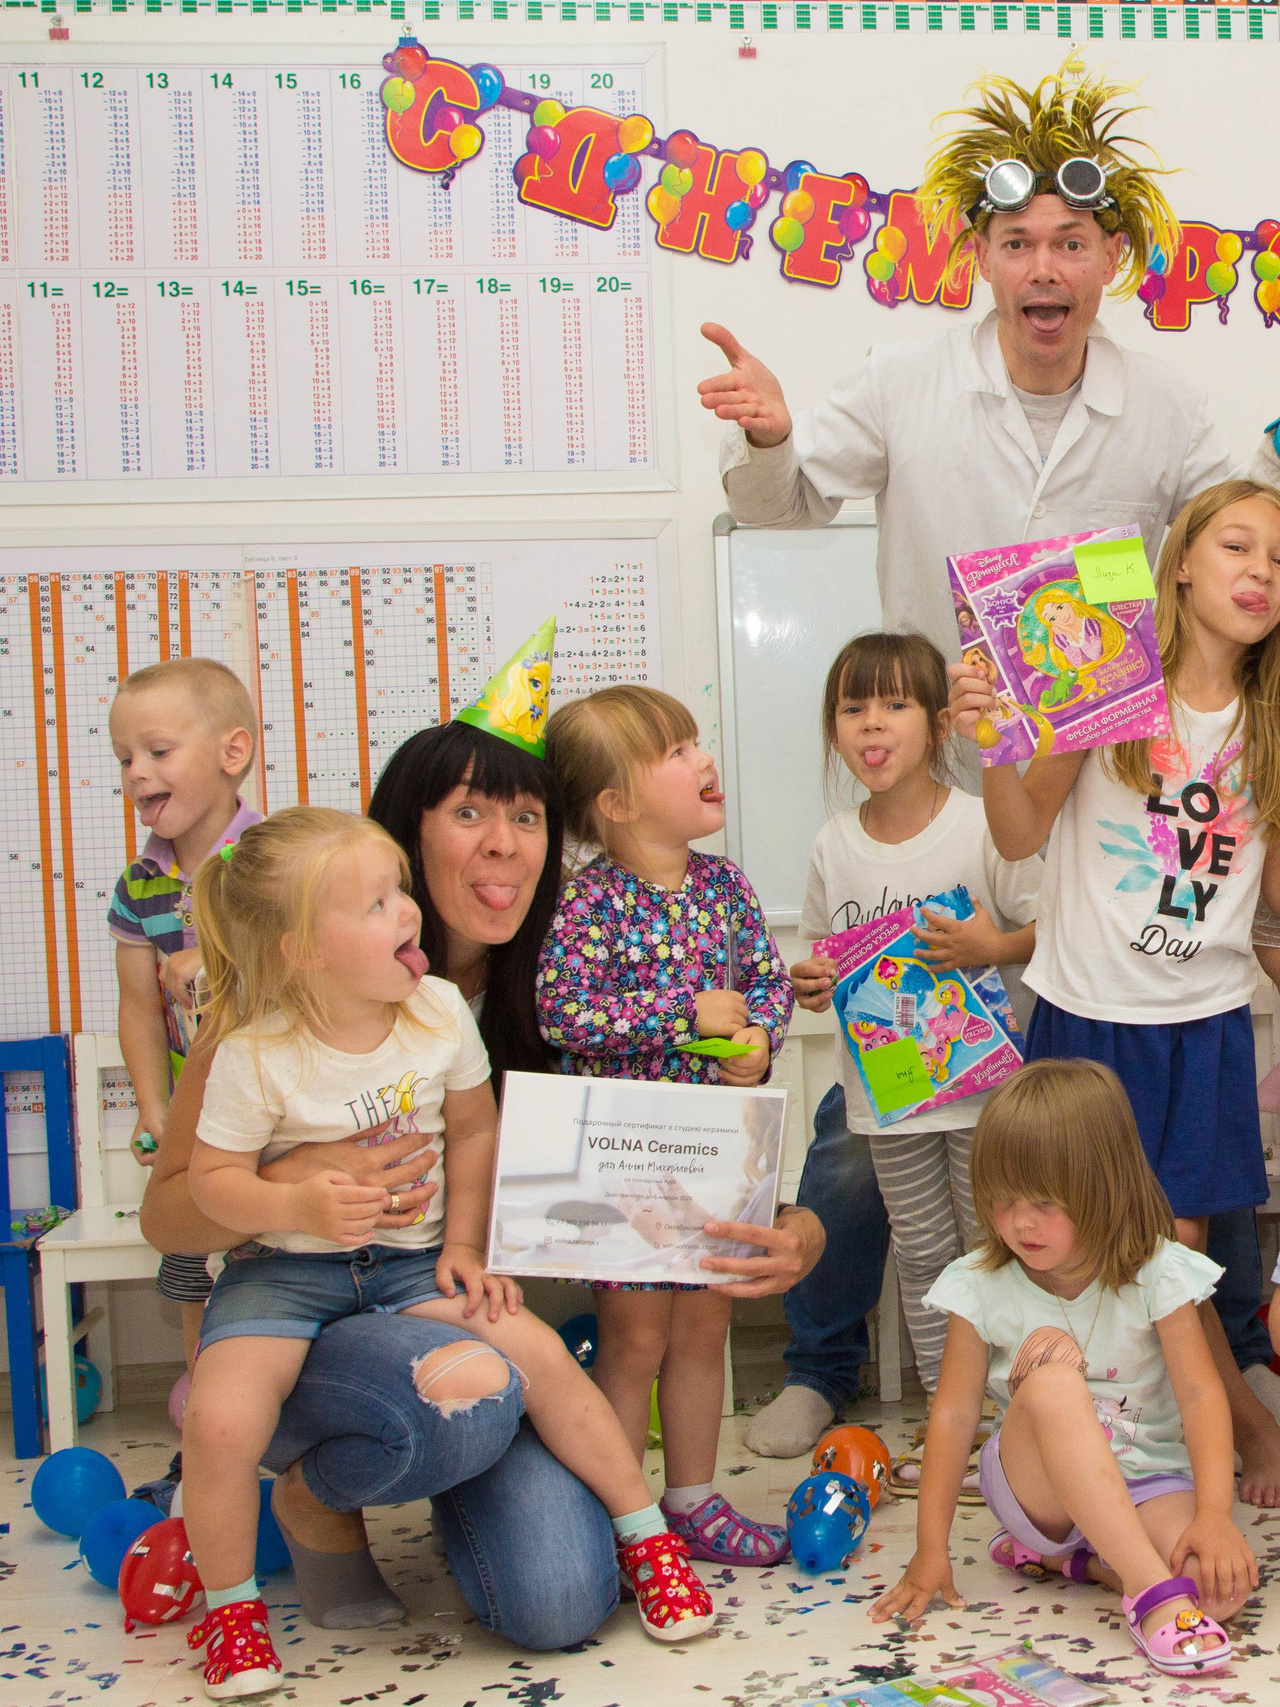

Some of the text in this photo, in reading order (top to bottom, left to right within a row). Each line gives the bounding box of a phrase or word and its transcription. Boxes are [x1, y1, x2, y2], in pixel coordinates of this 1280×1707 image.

[18, 72, 612, 88] 11 12 13 14 15 16 19 20
[975, 554, 1003, 568] Disney
[1111, 600, 1143, 612] БЛЕСТКИ
[1066, 693, 1158, 742] ФРЕСКА ФОРМЕННАЯ
[1078, 706, 1153, 745] набор для творчества
[871, 922, 899, 945] ФРЕСКА
[1130, 925, 1203, 963] Day
[963, 1025, 990, 1040] БЛЕСТКИ
[573, 1118, 622, 1128] Подарочный
[623, 1122, 667, 1132] сертификат
[588, 1136, 719, 1156] VOLNA Ceramics
[618, 1160, 644, 1171] Анны
